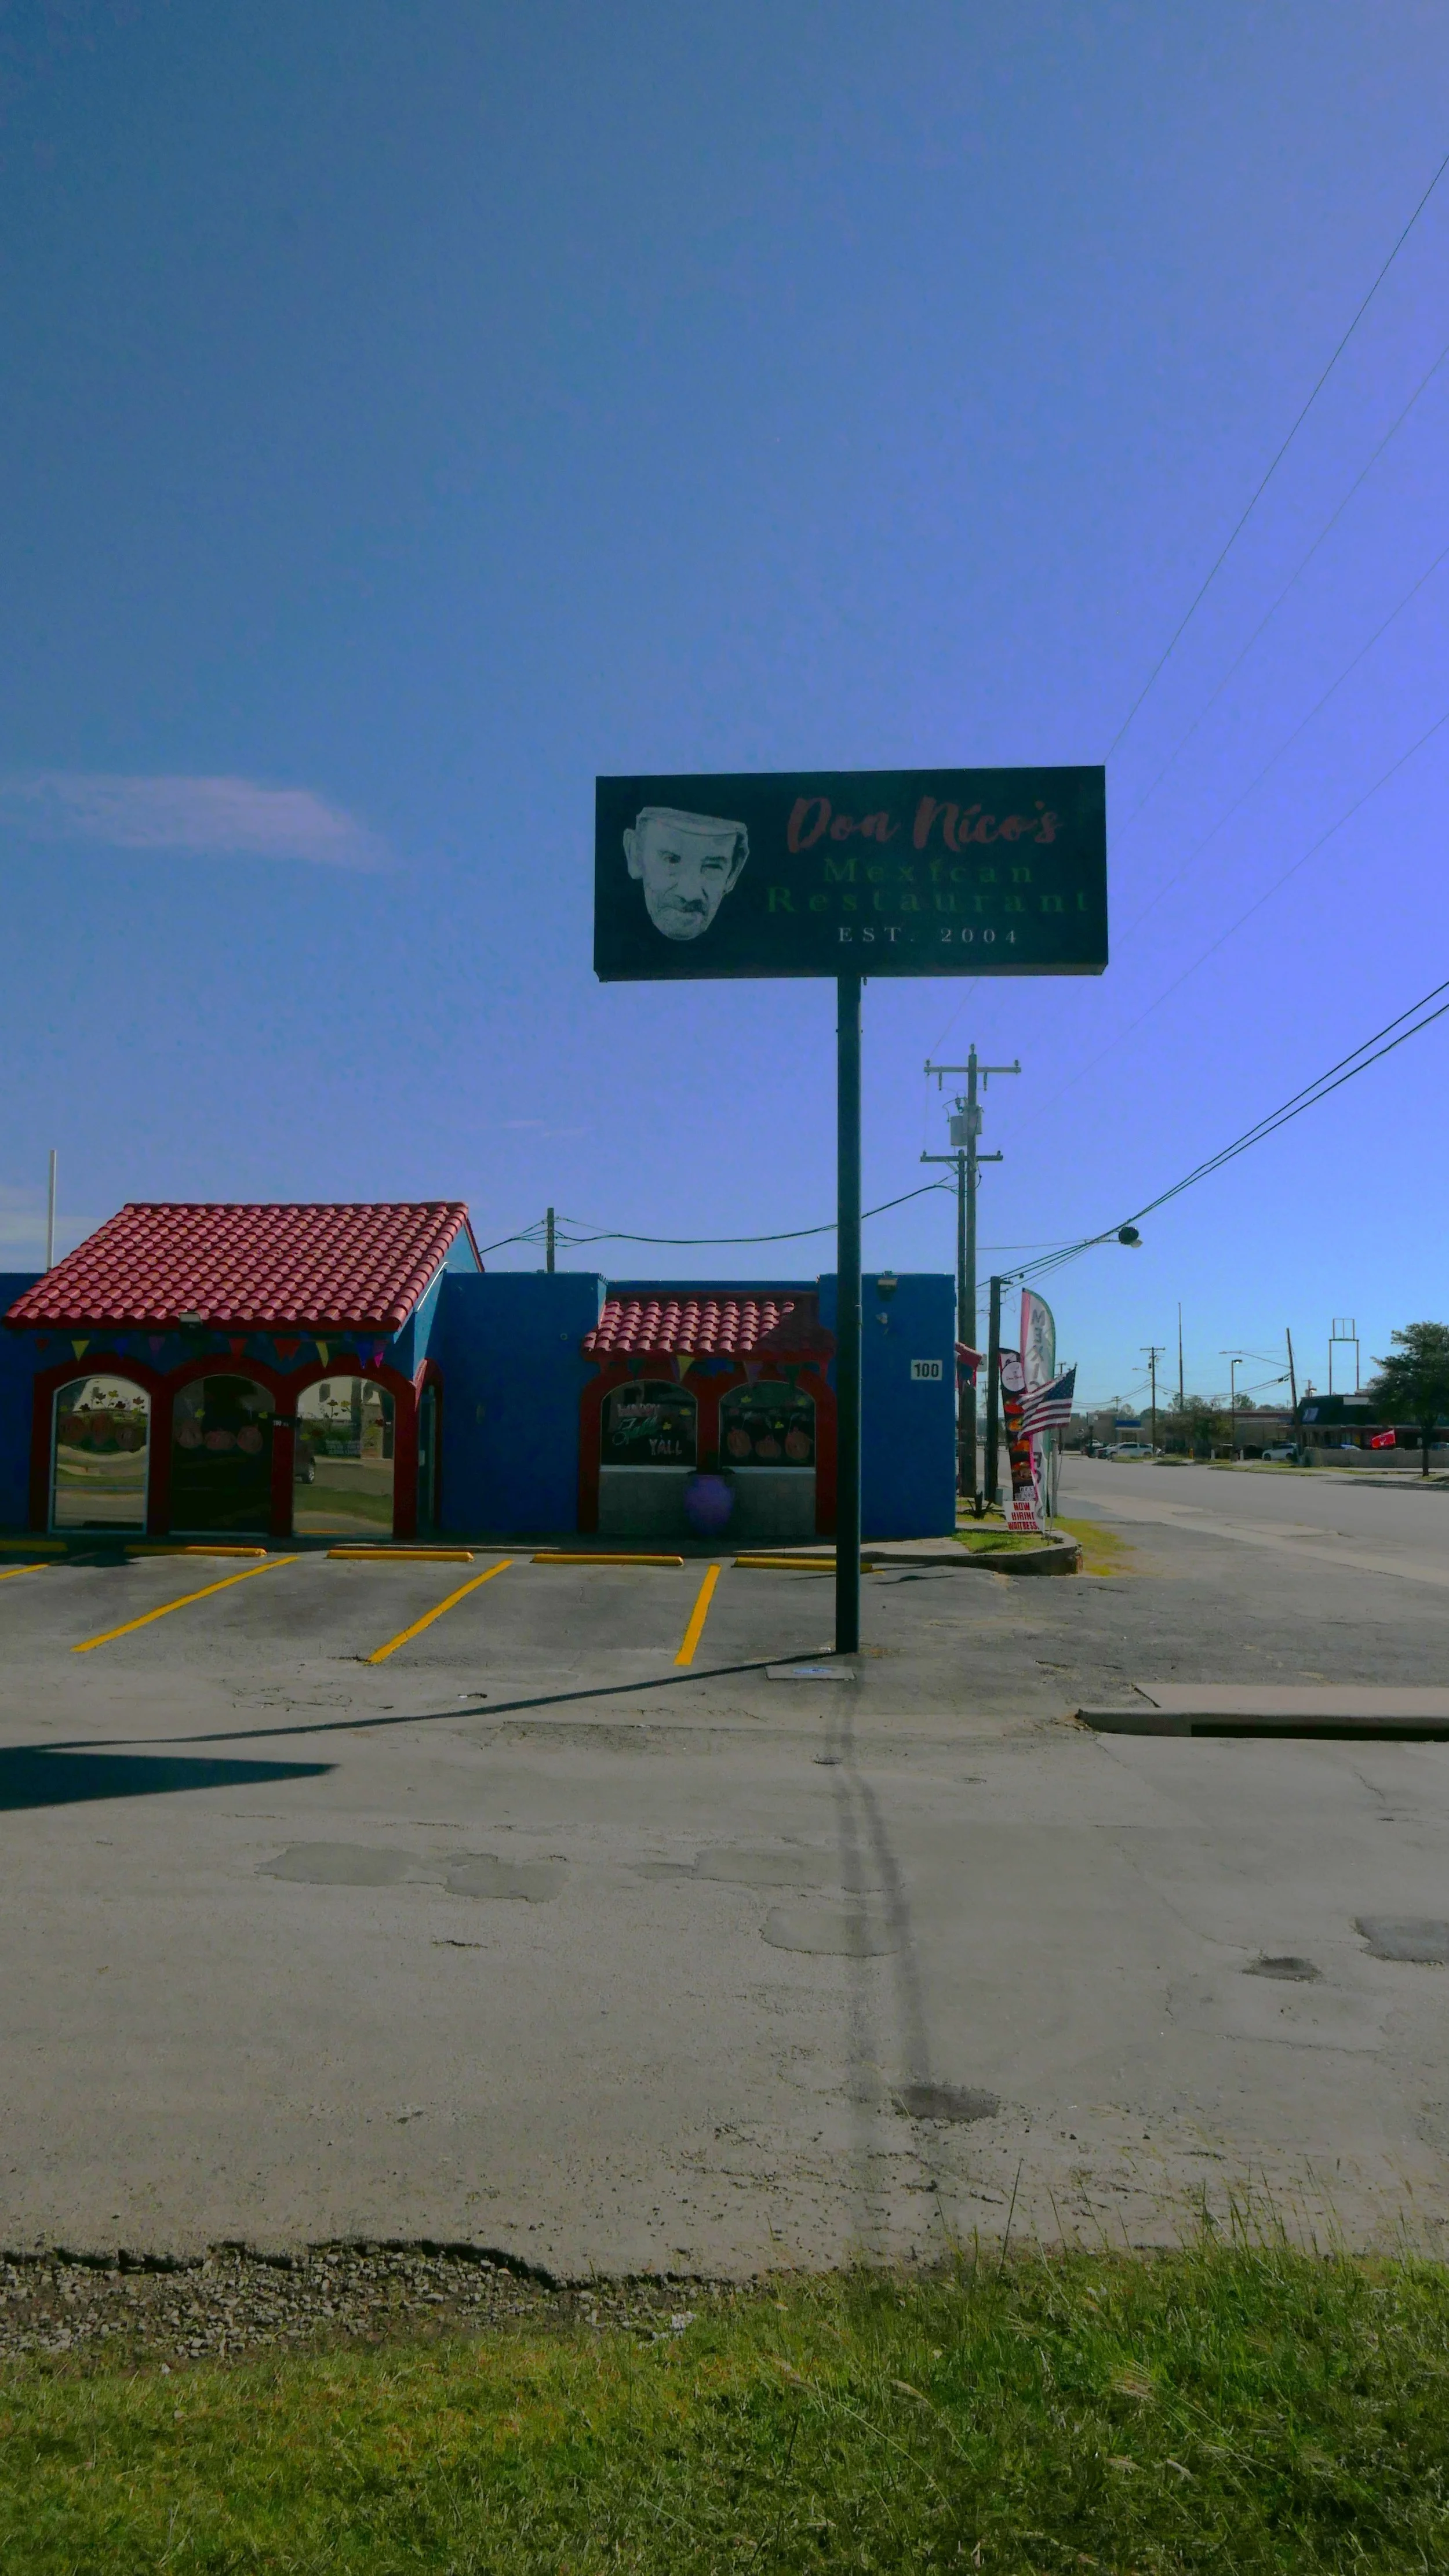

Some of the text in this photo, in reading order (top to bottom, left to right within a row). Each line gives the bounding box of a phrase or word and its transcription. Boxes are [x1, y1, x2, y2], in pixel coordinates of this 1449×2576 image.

[787, 796, 901, 853] Don
[823, 857, 1033, 883] Mexican
[766, 887, 1089, 912] Restaurant
[838, 927, 1017, 944] EST. 2004
[914, 1363, 939, 1377] 100
[1013, 1502, 1030, 1511] NOW
[1008, 1521, 1039, 1530] WAITRESS
